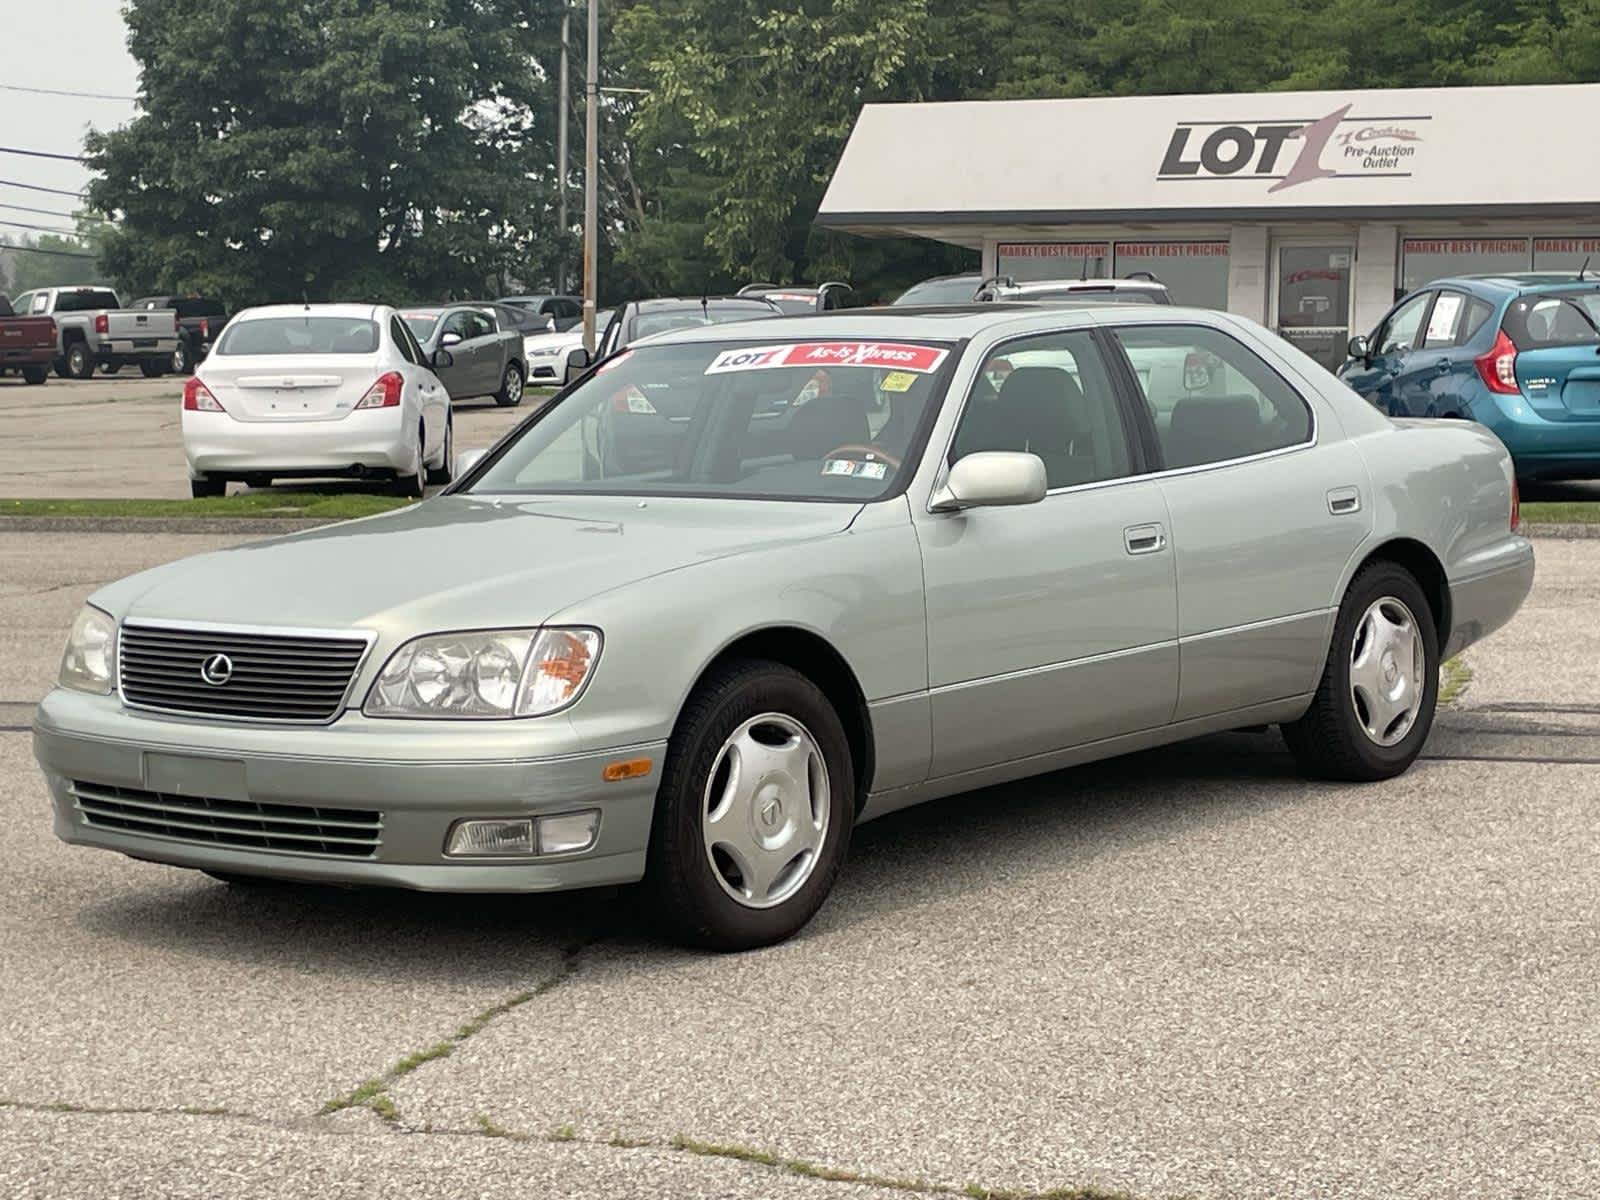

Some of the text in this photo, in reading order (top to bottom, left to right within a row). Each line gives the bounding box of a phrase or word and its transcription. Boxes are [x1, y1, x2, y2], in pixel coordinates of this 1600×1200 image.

[1343, 145, 1416, 157] Pre-Auction
[1362, 157, 1400, 168] Outlet
[1000, 246, 1108, 257] MARKET BEST PRICING
[1116, 245, 1230, 257] MARKET BEST PRICING
[1405, 241, 1526, 253] MARKET BEST PRICING
[1534, 240, 1580, 252] MARKET
